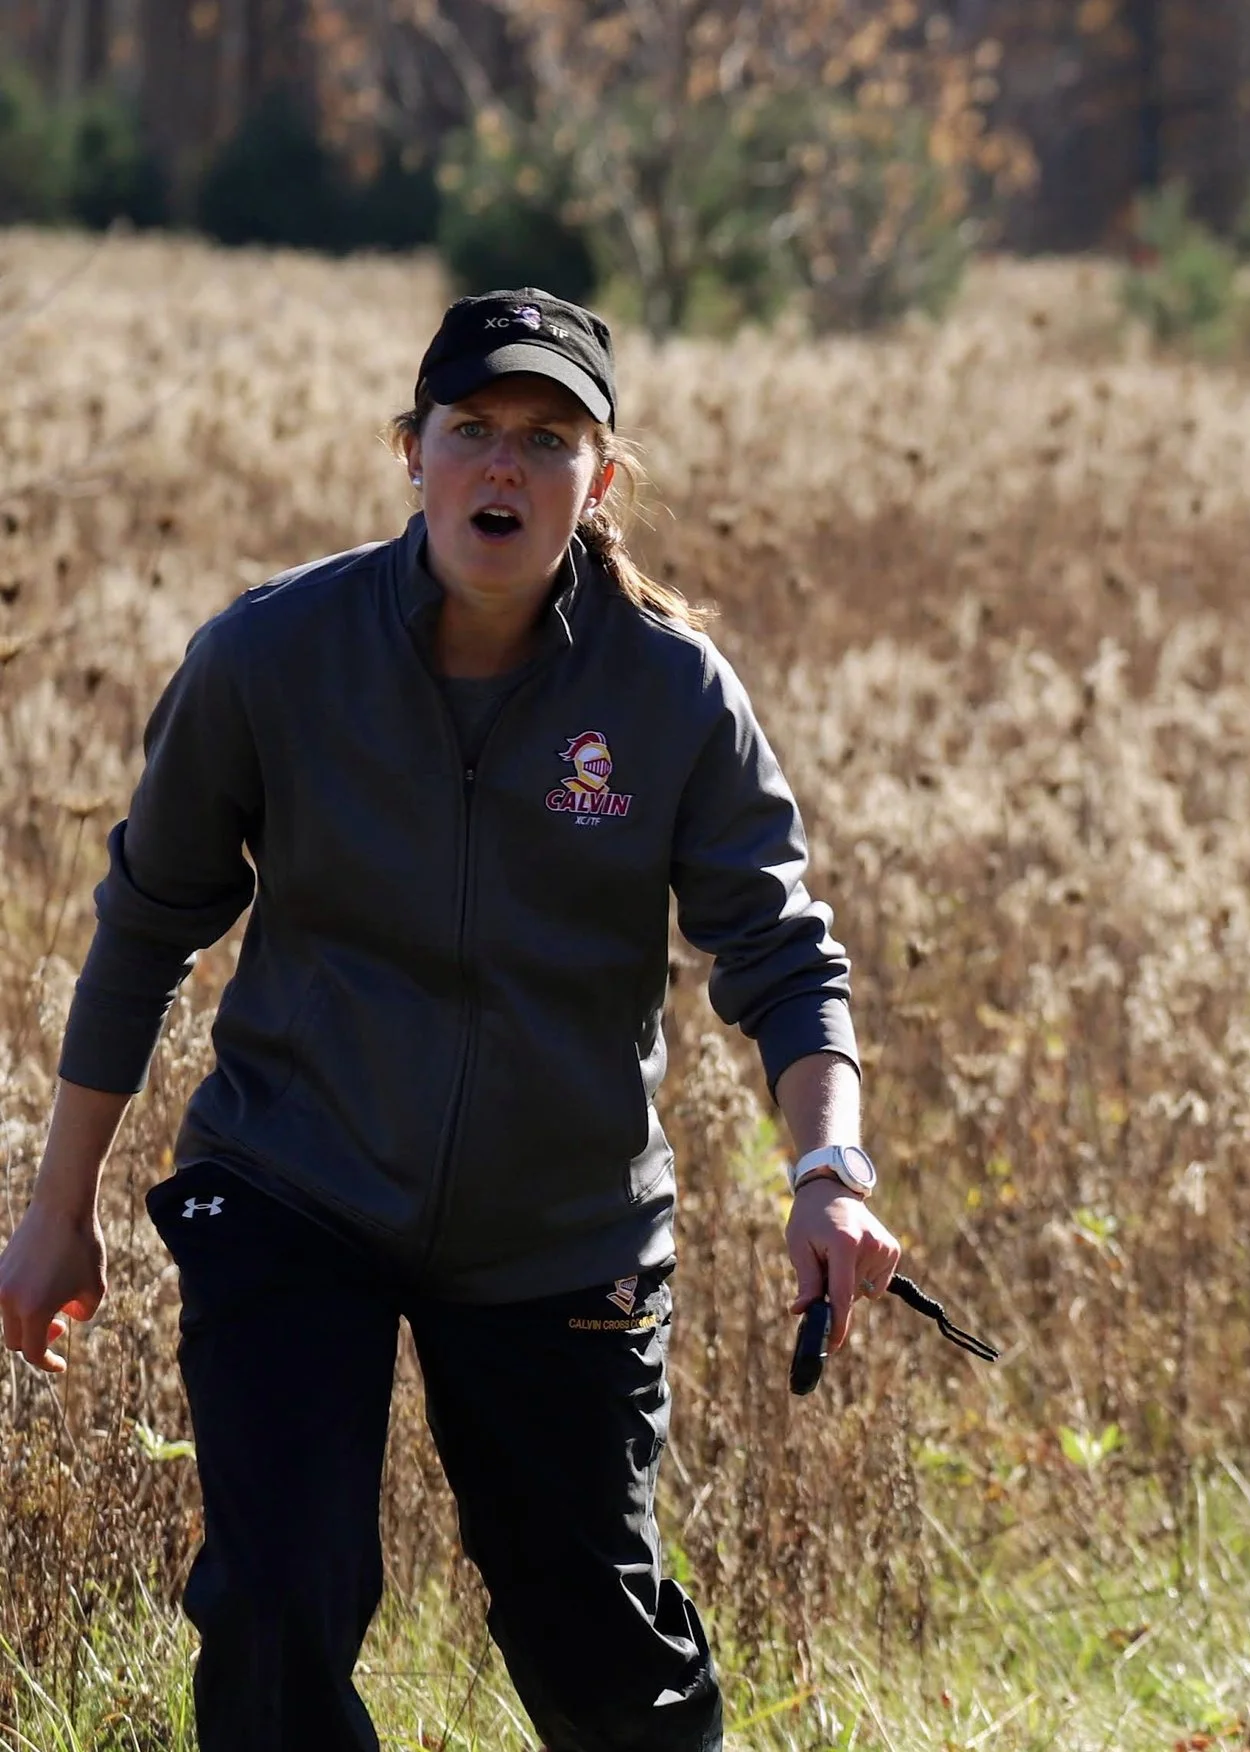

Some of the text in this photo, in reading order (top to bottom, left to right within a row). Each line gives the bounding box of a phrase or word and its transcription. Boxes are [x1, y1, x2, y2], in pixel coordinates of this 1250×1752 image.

[484, 317, 510, 329] XC
[549, 324, 569, 339] TF
[545, 788, 632, 816] CALVIN
[575, 816, 601, 826] XC/TF
[568, 1318, 601, 1330] CALVIN
[602, 1319, 629, 1330] CROSS
